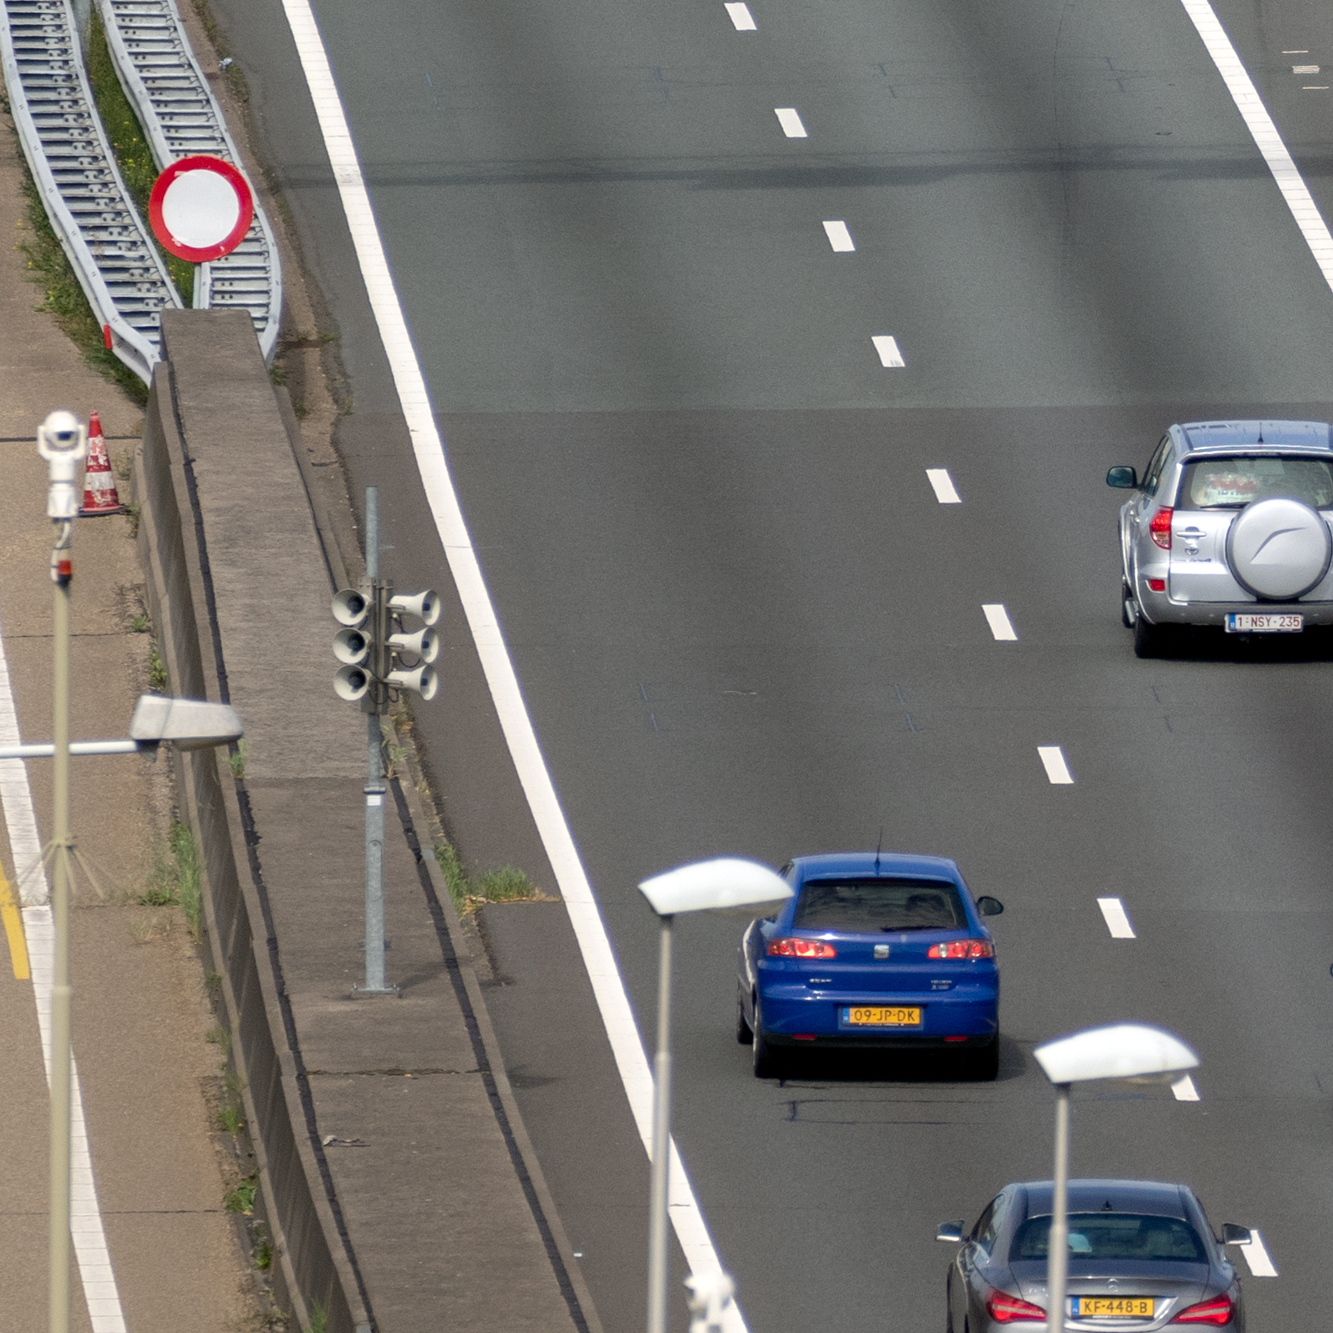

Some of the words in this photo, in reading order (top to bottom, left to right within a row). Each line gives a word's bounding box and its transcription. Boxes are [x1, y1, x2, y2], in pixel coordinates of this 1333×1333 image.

[1238, 616, 1300, 628] 1-NSY-235
[854, 1009, 916, 1022] 09-JP-DK
[1084, 1300, 1148, 1314] KF-448-B
